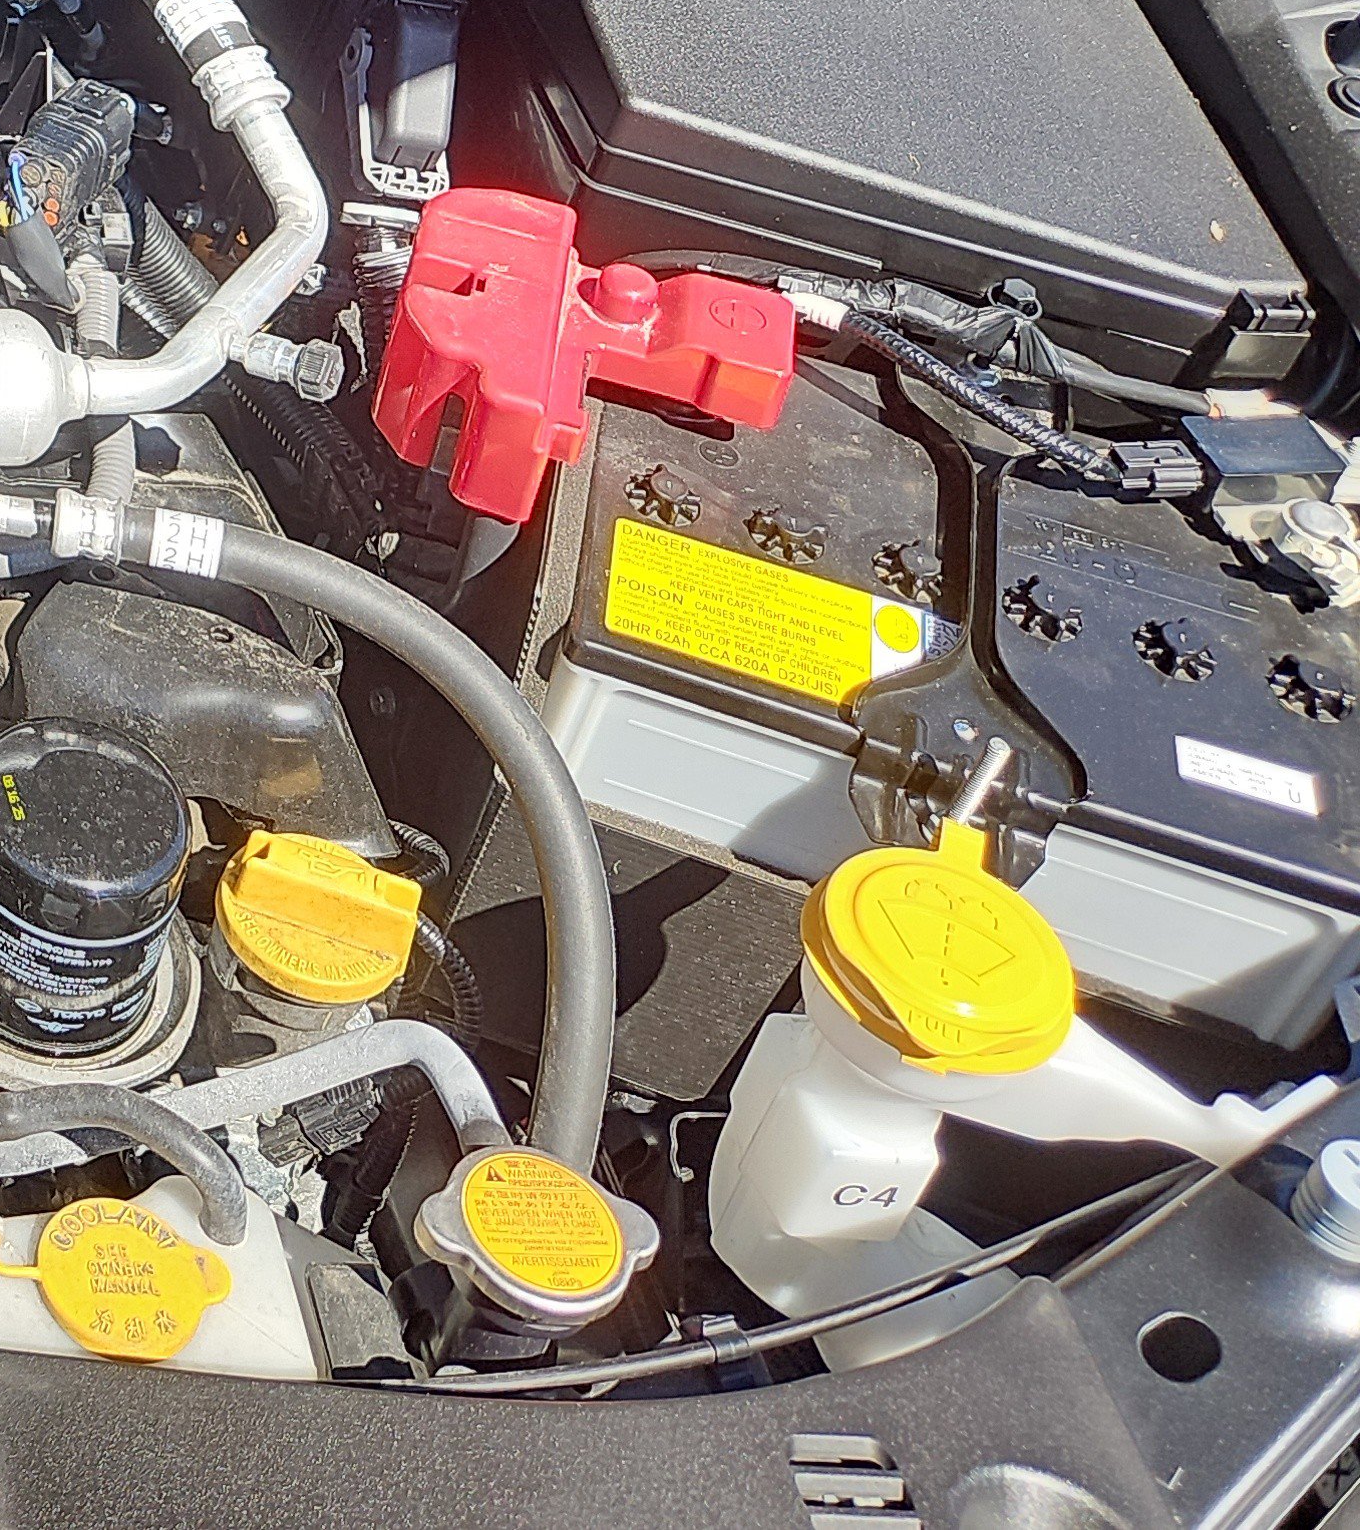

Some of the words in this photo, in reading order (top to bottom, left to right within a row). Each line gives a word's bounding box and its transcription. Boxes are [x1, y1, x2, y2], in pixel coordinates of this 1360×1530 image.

[622, 524, 691, 554] DANGER
[698, 548, 751, 571] EXPLOSIVE
[755, 563, 789, 582] GASES
[616, 575, 684, 606] POISON
[695, 601, 734, 621] CAUSES
[739, 614, 778, 634] SEVERE
[781, 627, 816, 647] BURNS
[670, 579, 696, 593] KEEP
[699, 589, 724, 603] VENT
[727, 598, 754, 613] CAPS
[758, 606, 786, 623] TIGHT
[789, 616, 810, 630] AND
[813, 624, 845, 642] LEVEL
[614, 616, 651, 637] 20HR
[655, 629, 690, 650] 62Ah
[699, 643, 731, 663] CCA
[735, 656, 769, 675] 620A
[778, 667, 839, 697] D23(JIS)
[665, 619, 692, 634] KEEP
[694, 629, 714, 642] OUT
[718, 637, 732, 647] OF
[735, 641, 770, 660] REACH
[773, 652, 786, 664] OF
[790, 658, 841, 682] CHILDREN
[235, 911, 258, 936] SEE
[256, 935, 320, 978] OWNER'S
[325, 956, 384, 981] MANUAL
[50, 1009, 106, 1019] TOKYO
[504, 1169, 563, 1180] WARNING
[475, 1208, 508, 1217] NEVER
[513, 1209, 538, 1218] OPEN
[545, 1210, 573, 1219] WHEN
[833, 1185, 899, 1207] C4
[49, 1203, 180, 1251] COOLANT
[94, 1243, 128, 1260] SEE
[511, 1256, 601, 1268] AVERTISSEMENT
[90, 1278, 161, 1296] MANUAL
